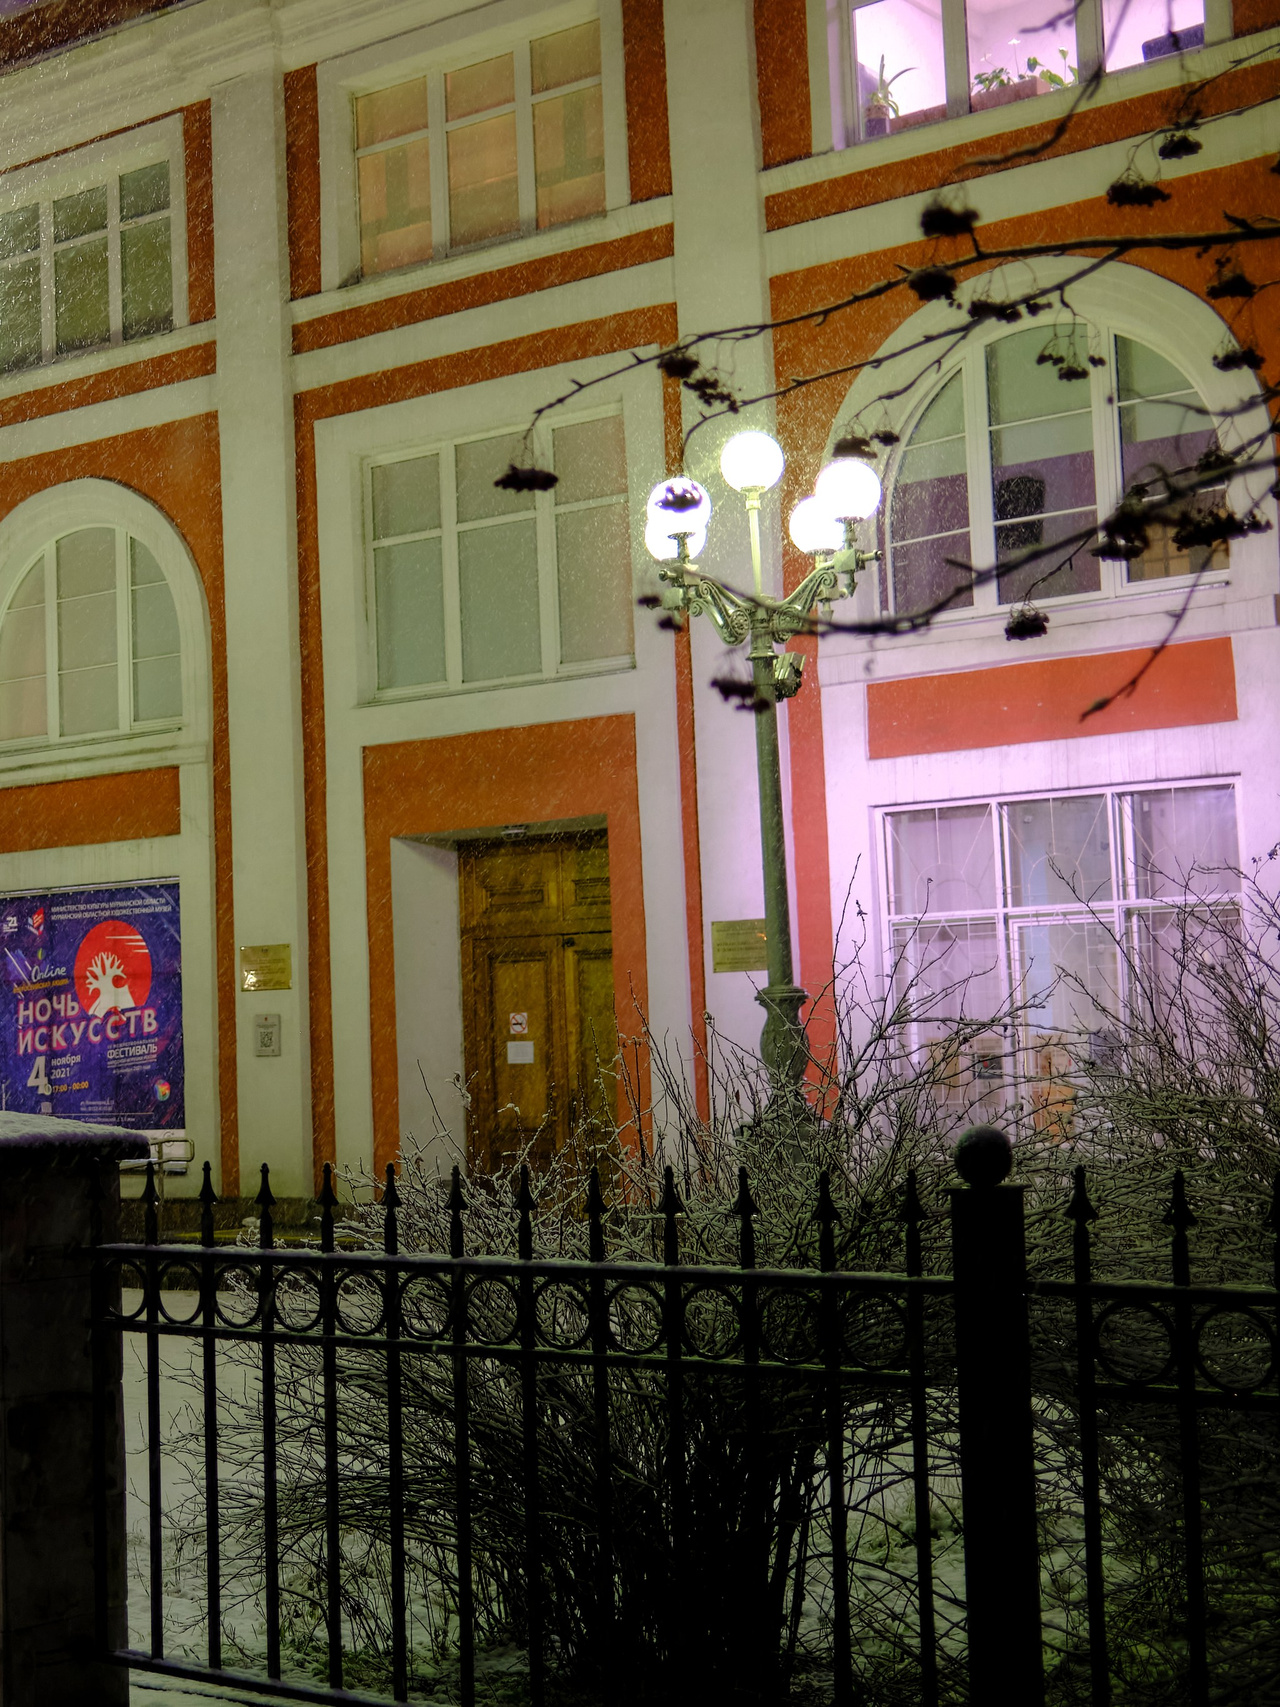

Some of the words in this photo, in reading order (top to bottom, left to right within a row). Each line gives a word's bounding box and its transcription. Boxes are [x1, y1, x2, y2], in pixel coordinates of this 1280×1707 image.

[31, 964, 67, 983] Online
[18, 994, 80, 1025] НОЧЬ
[18, 1008, 158, 1055] ИСКУССТВ
[107, 1044, 158, 1059] ФЕСТИВАЛЬ
[27, 1055, 49, 1095] 4
[51, 1054, 81, 1066] ноября
[51, 1067, 70, 1079] 2021
